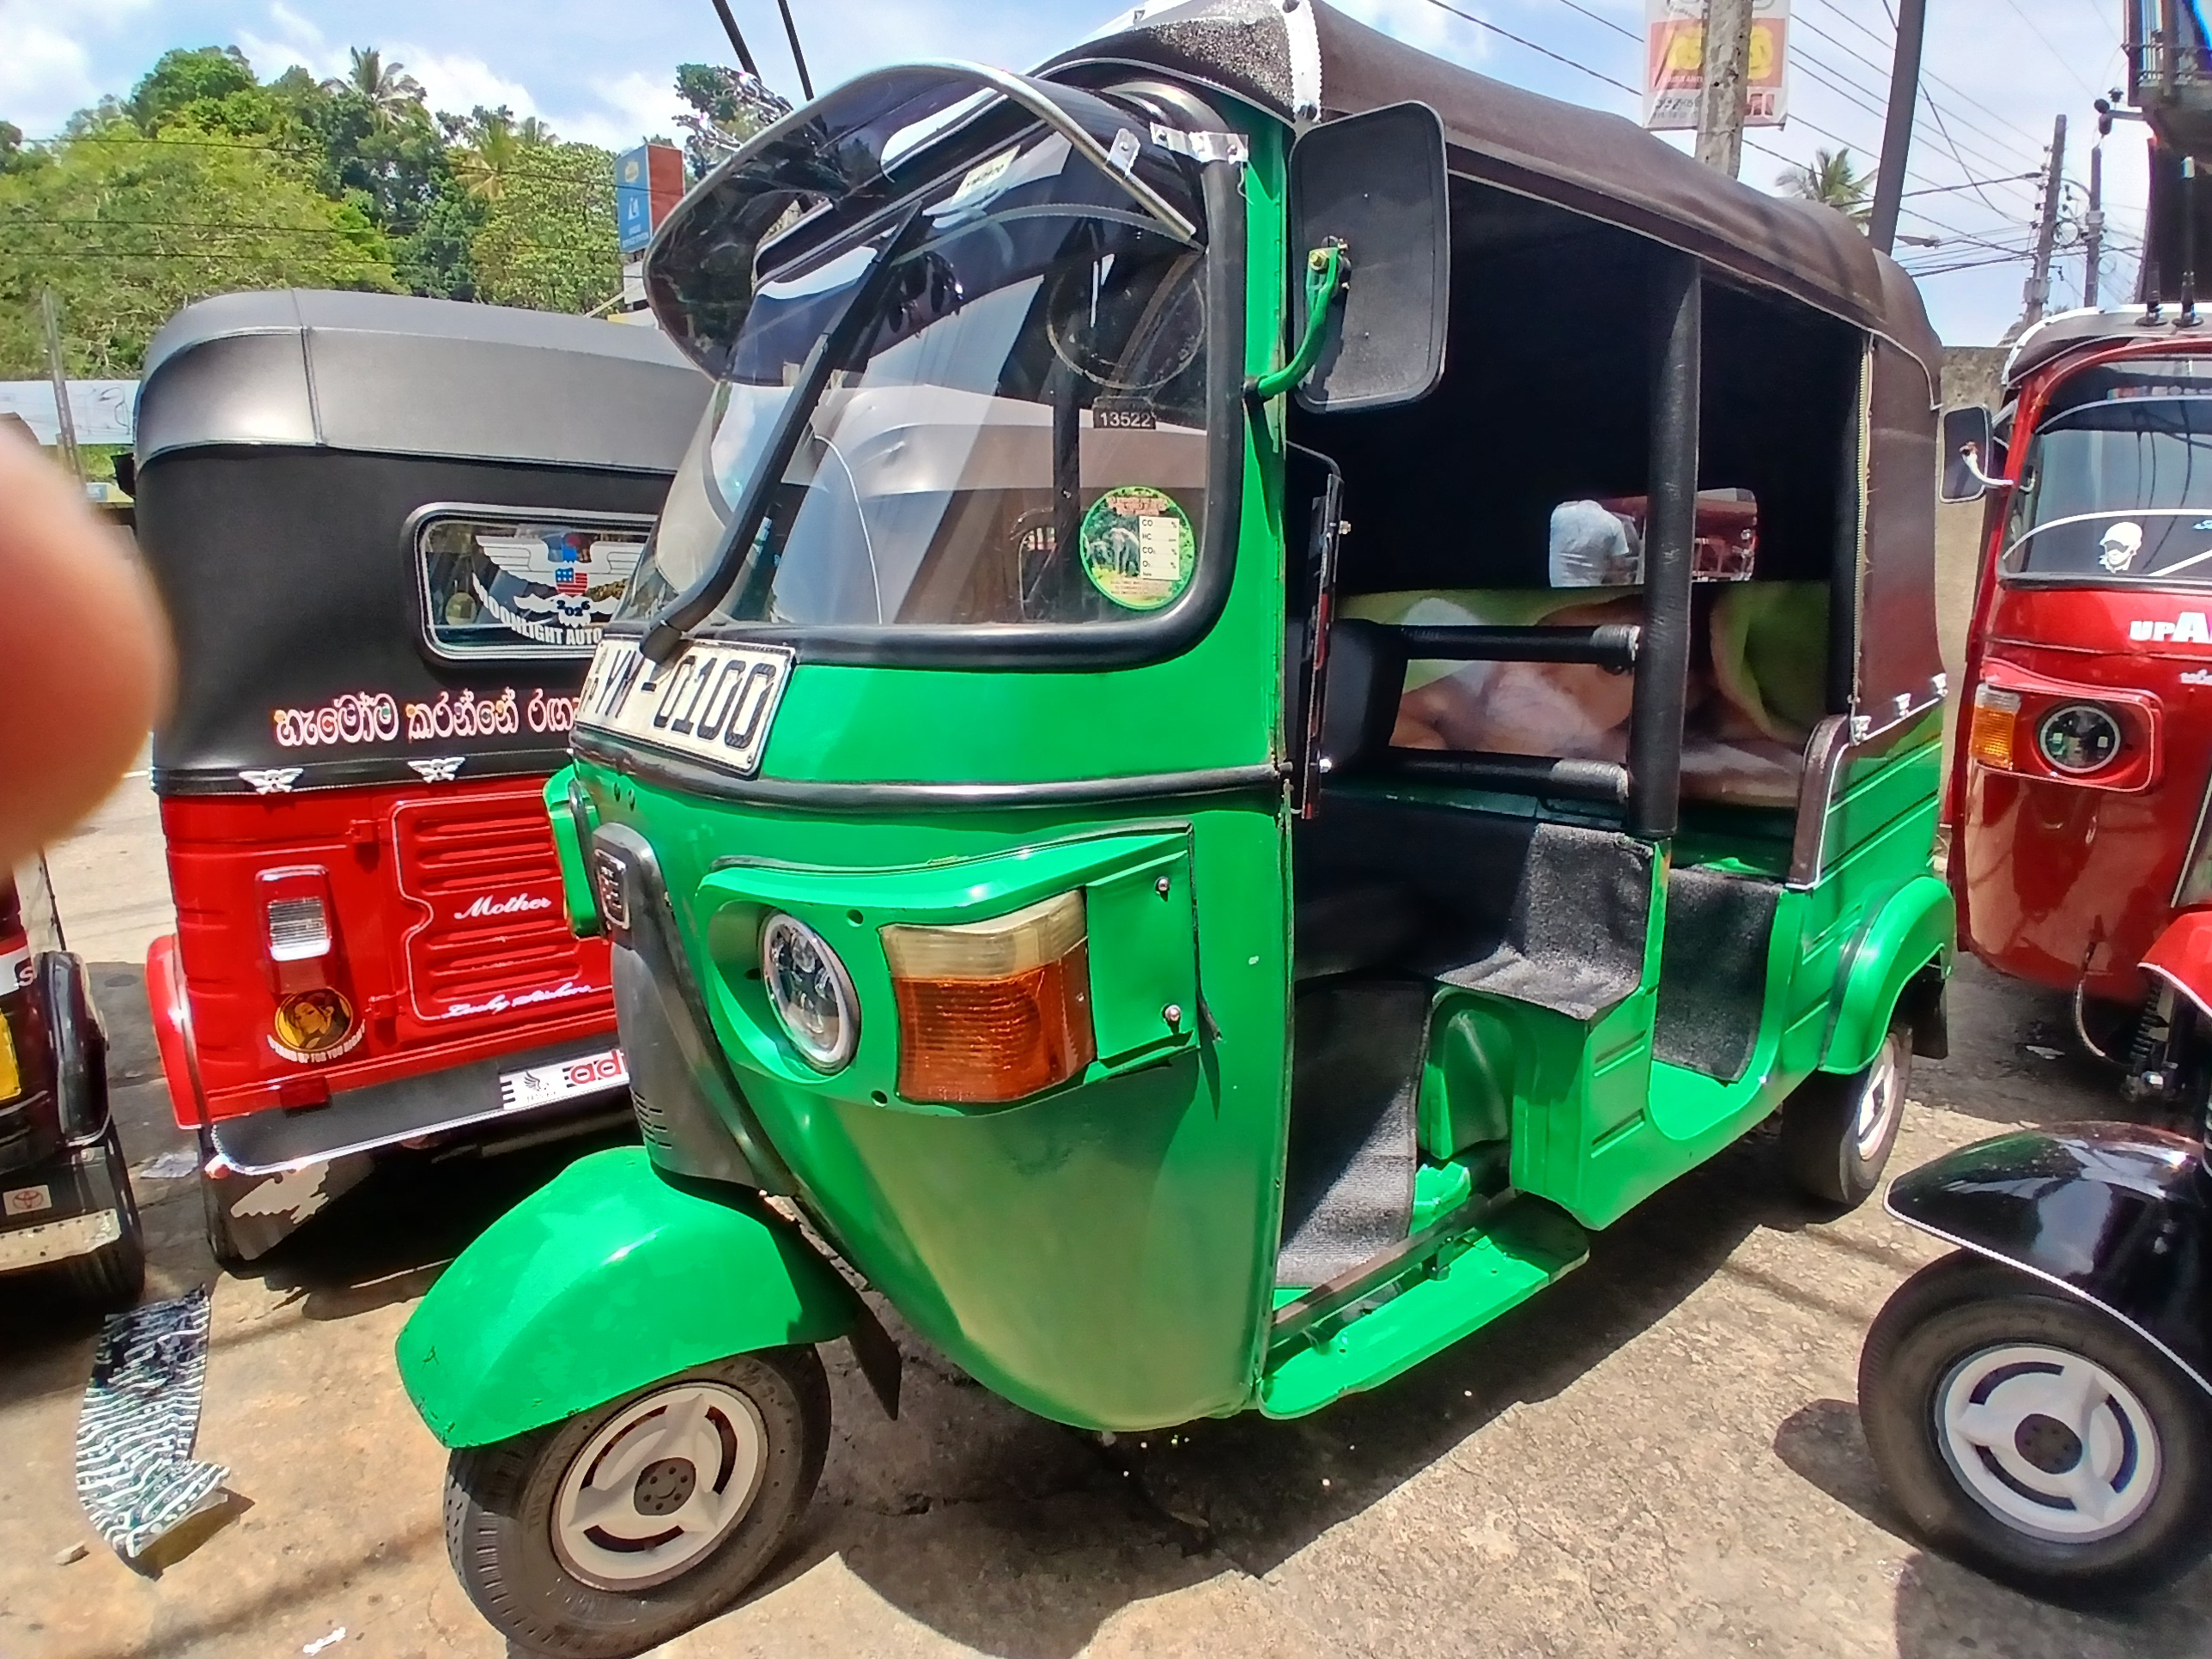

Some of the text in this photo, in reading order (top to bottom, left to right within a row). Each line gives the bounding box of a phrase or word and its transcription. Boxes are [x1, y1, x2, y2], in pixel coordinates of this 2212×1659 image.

[1100, 411, 1151, 428] 13522
[472, 572, 602, 645] MOONLIGHT AUTO
[556, 599, 591, 617] 2026
[2129, 611, 2212, 644] UPA
[273, 690, 399, 747] හැමෝම
[405, 686, 520, 744] කරන්නේ
[453, 892, 552, 920] Mother
